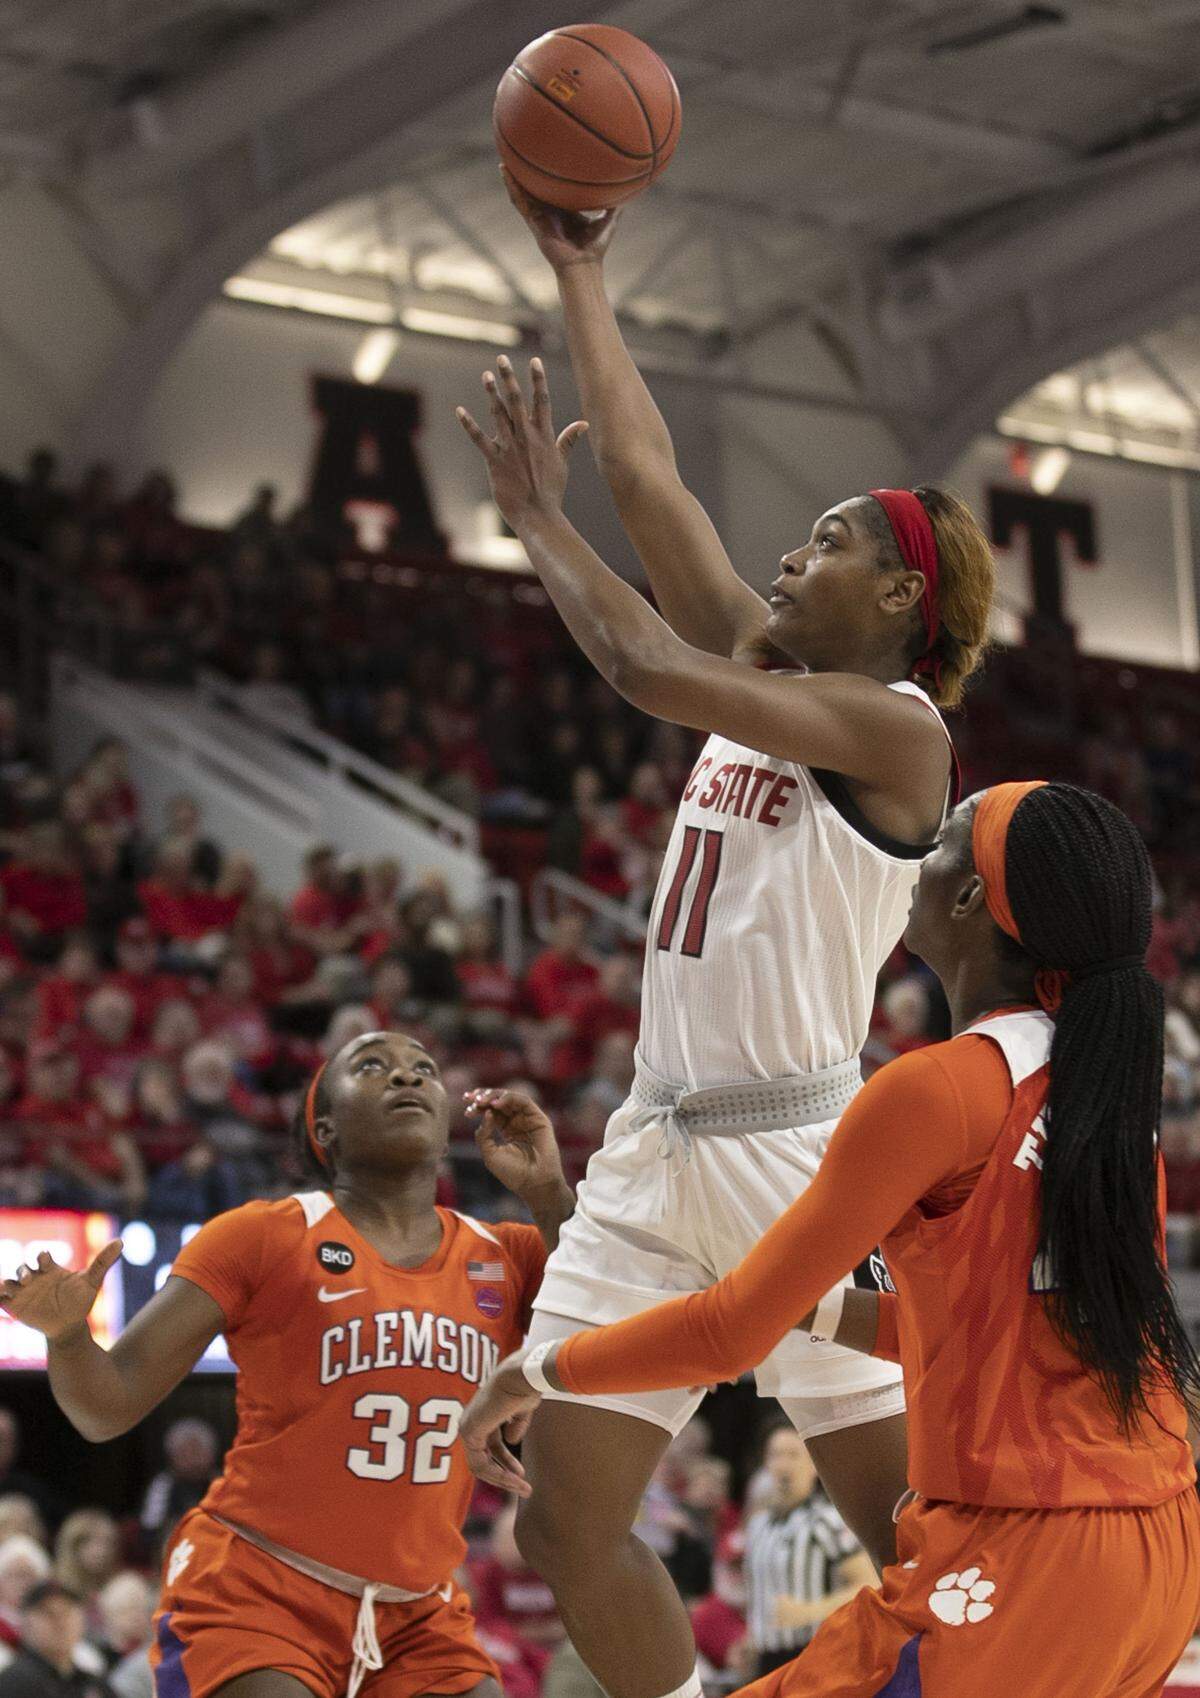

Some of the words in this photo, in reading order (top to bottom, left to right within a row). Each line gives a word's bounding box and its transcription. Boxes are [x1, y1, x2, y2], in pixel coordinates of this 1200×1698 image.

[989, 488, 1099, 649] T
[699, 763, 798, 827] STATE
[657, 825, 724, 959] 11
[321, 1248, 353, 1266] BKD
[320, 1310, 500, 1387] CLEMSON
[347, 1393, 465, 1484] 32
